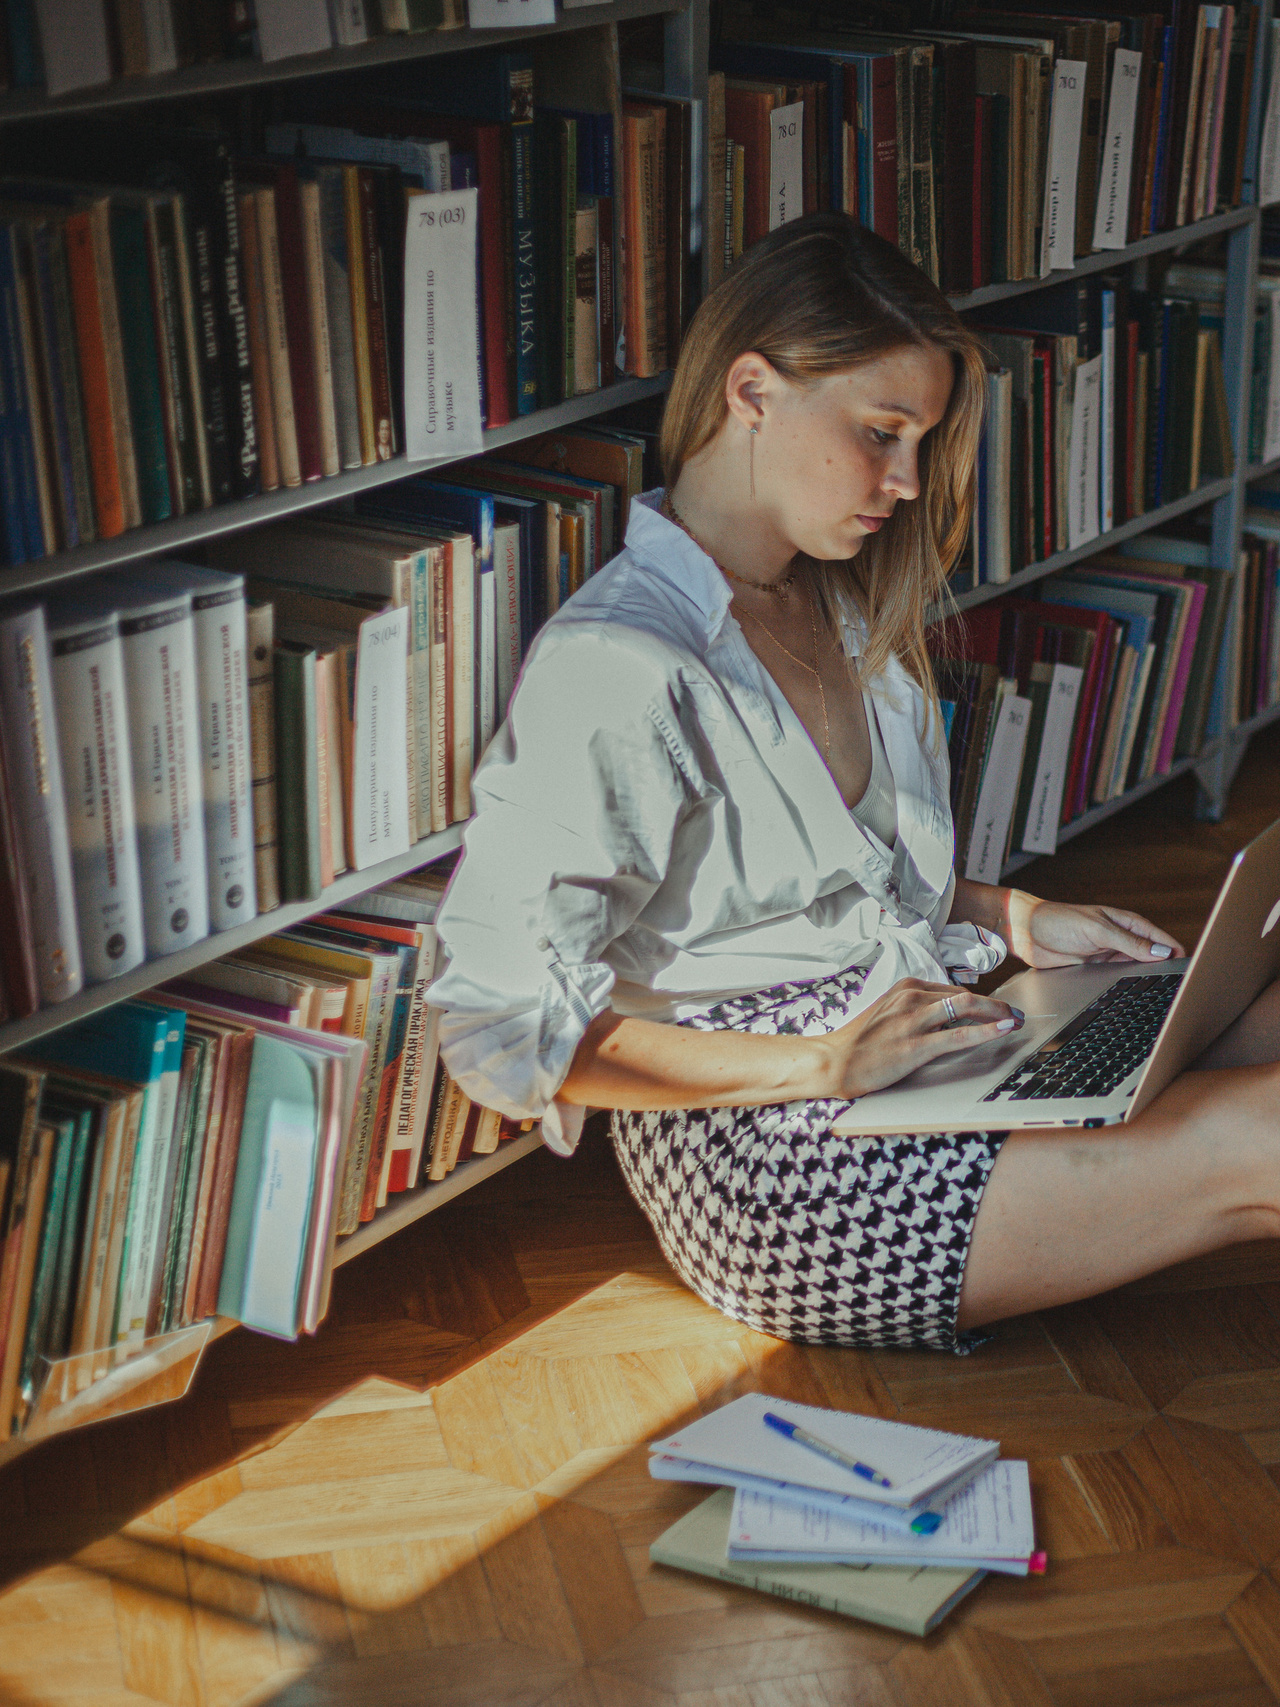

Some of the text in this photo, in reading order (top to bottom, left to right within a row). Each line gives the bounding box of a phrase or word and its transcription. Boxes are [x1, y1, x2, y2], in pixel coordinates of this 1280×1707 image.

[419, 206, 465, 228] 78 (03)
[517, 229, 536, 356] МУЗЫКА
[425, 270, 438, 434] Справочные издания по
[444, 381, 456, 432] музыке
[210, 702, 221, 746] Герцман
[220, 624, 239, 839] ЭНЦИКЛОПЕДИЯ ДРЕВНЕЭЛЛИНСКОЙ
[368, 685, 379, 844] Популярные издания по
[419, 736, 430, 784] ПИСАЛ
[437, 729, 446, 778] ПИСАЛ
[382, 790, 392, 839] музыке
[420, 787, 430, 814] КТО
[437, 781, 447, 808] КТО
[355, 978, 389, 1172] МУЗЫКАЛЬНОЕ РАЗВИТИЕ ДЕТЕЙ
[396, 1037, 418, 1137] ПЕДАГОГИЧЕСКАЯ
[408, 977, 426, 1035] ПРАКТИКА
[407, 1080, 420, 1137] ПОДГОТОВКА
[428, 1107, 443, 1156] СОВРЕМЕННАЯ
[440, 1099, 458, 1163] МЕТОДИКА
